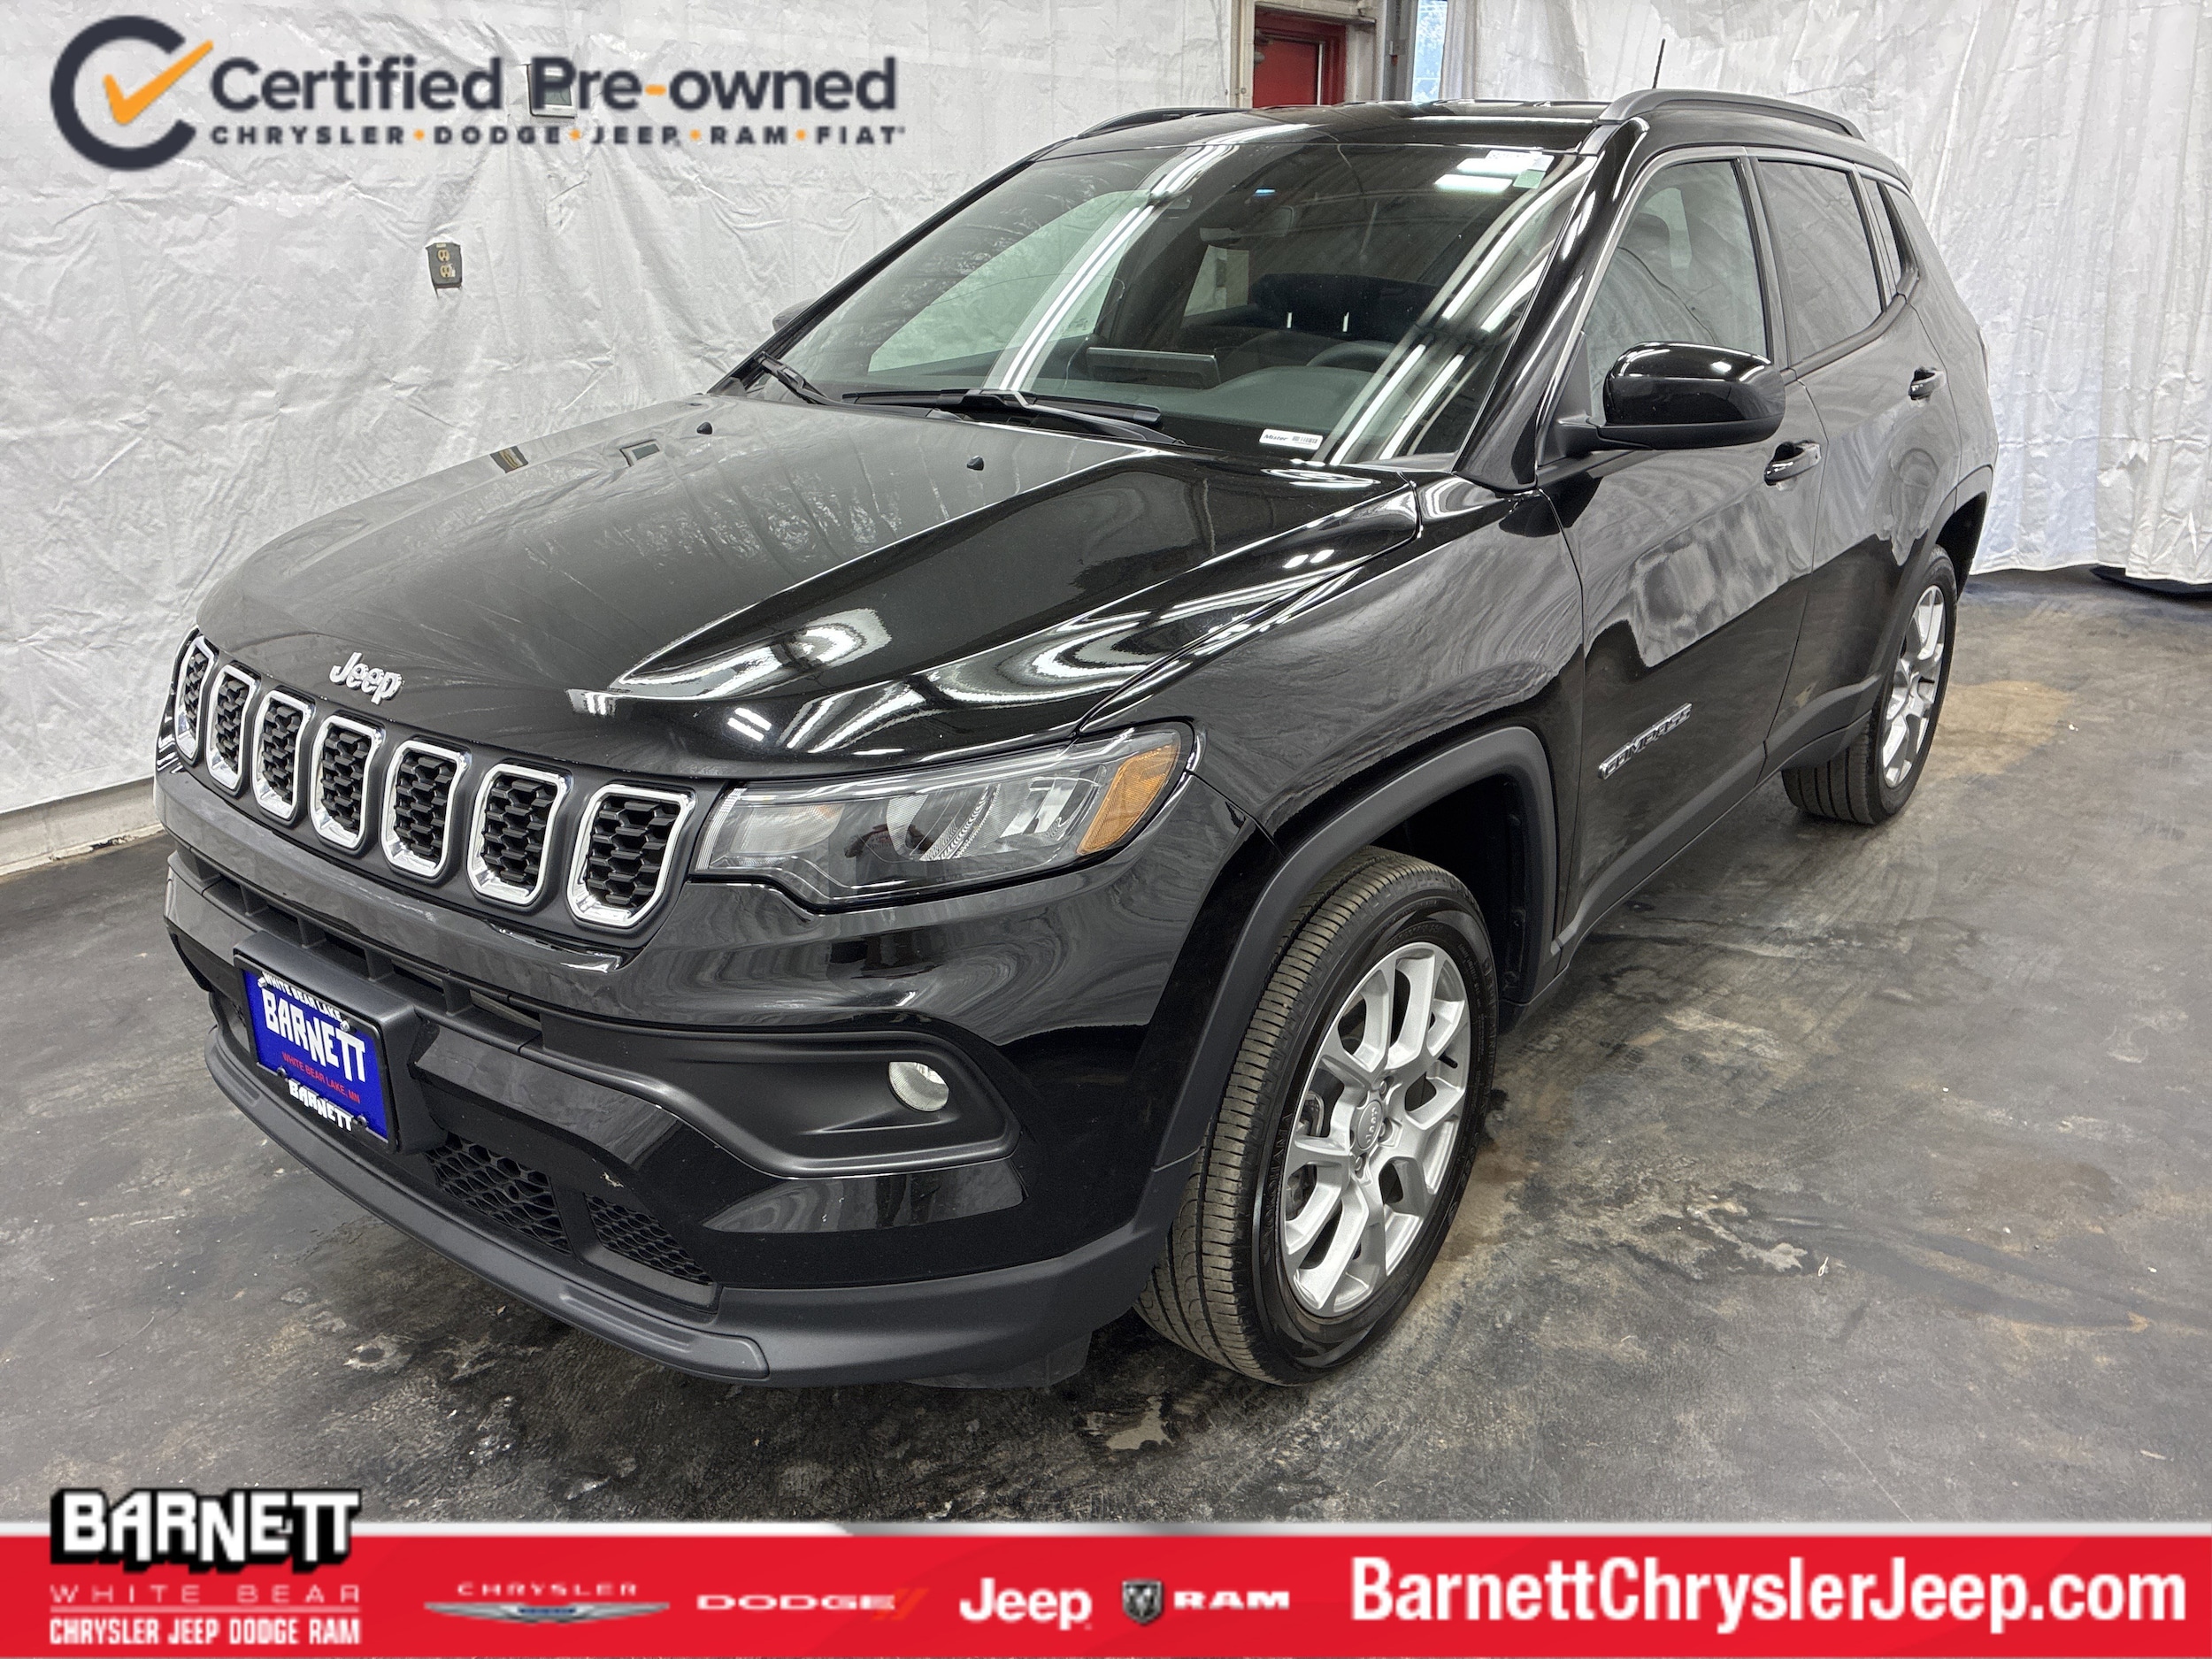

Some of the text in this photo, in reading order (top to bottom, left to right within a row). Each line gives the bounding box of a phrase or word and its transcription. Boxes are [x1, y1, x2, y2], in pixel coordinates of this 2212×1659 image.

[329, 651, 405, 705] Jeep
[262, 971, 343, 1023] WHITE BEAR LAKE
[262, 988, 365, 1083] BARNETT
[282, 1051, 305, 1072] WHITE
[305, 1064, 326, 1084] BEAR
[348, 1089, 360, 1104] MN
[288, 1078, 354, 1132] BARNETT
